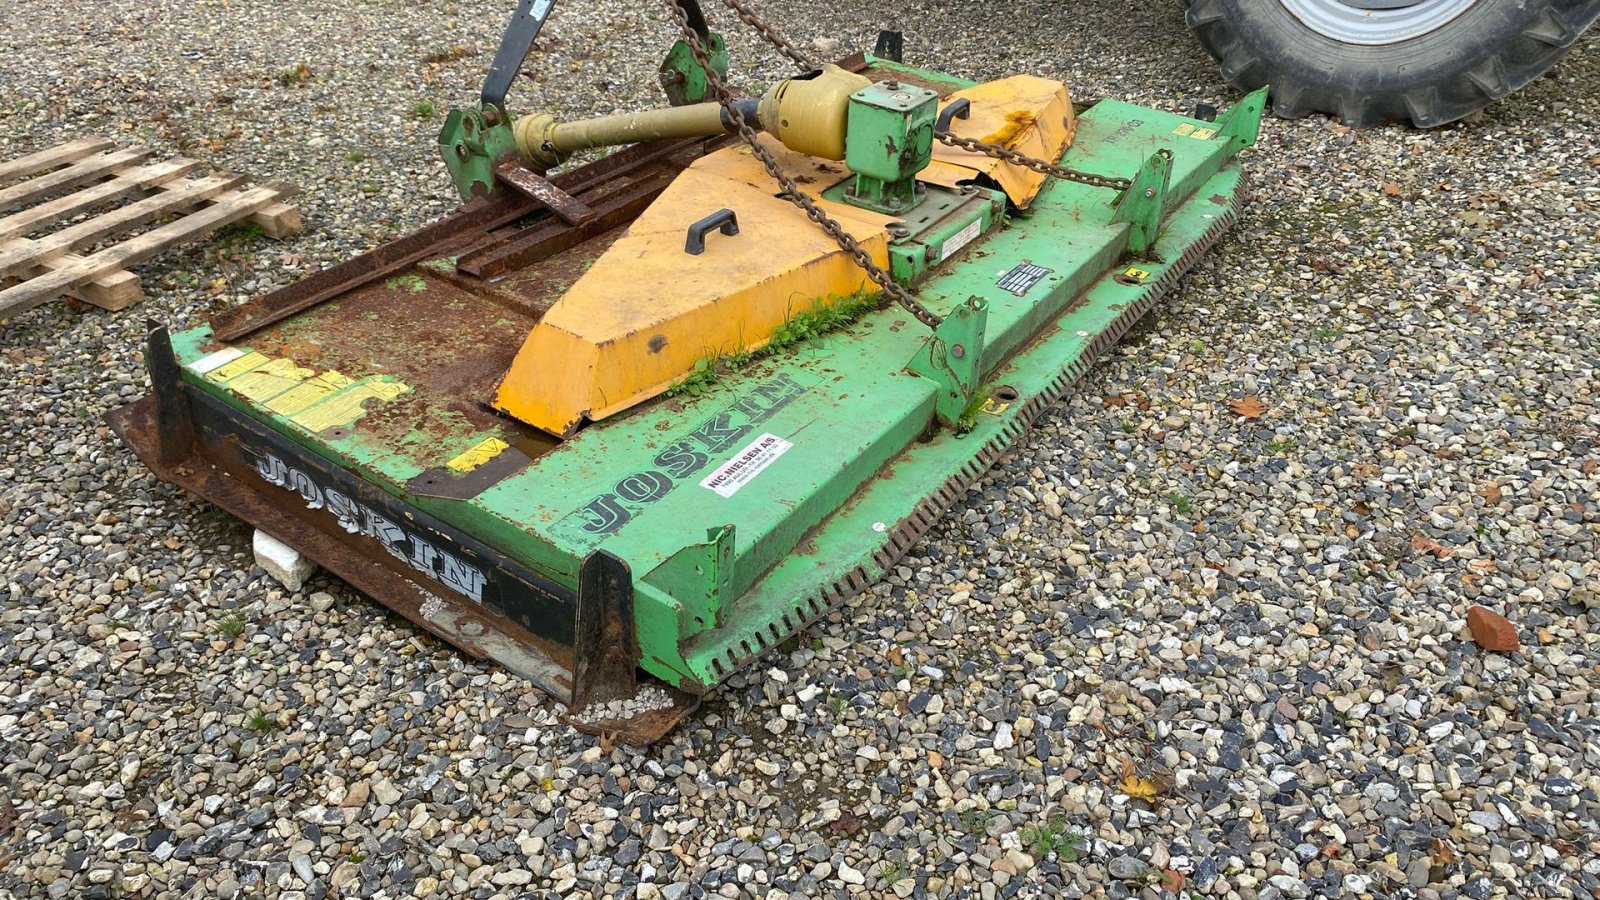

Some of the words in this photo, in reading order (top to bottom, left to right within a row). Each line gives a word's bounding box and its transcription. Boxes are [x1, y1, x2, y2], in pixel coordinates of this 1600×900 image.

[579, 372, 808, 534] JOSKIN
[760, 437, 776, 449] A/S
[256, 453, 486, 604] JOSKIN
